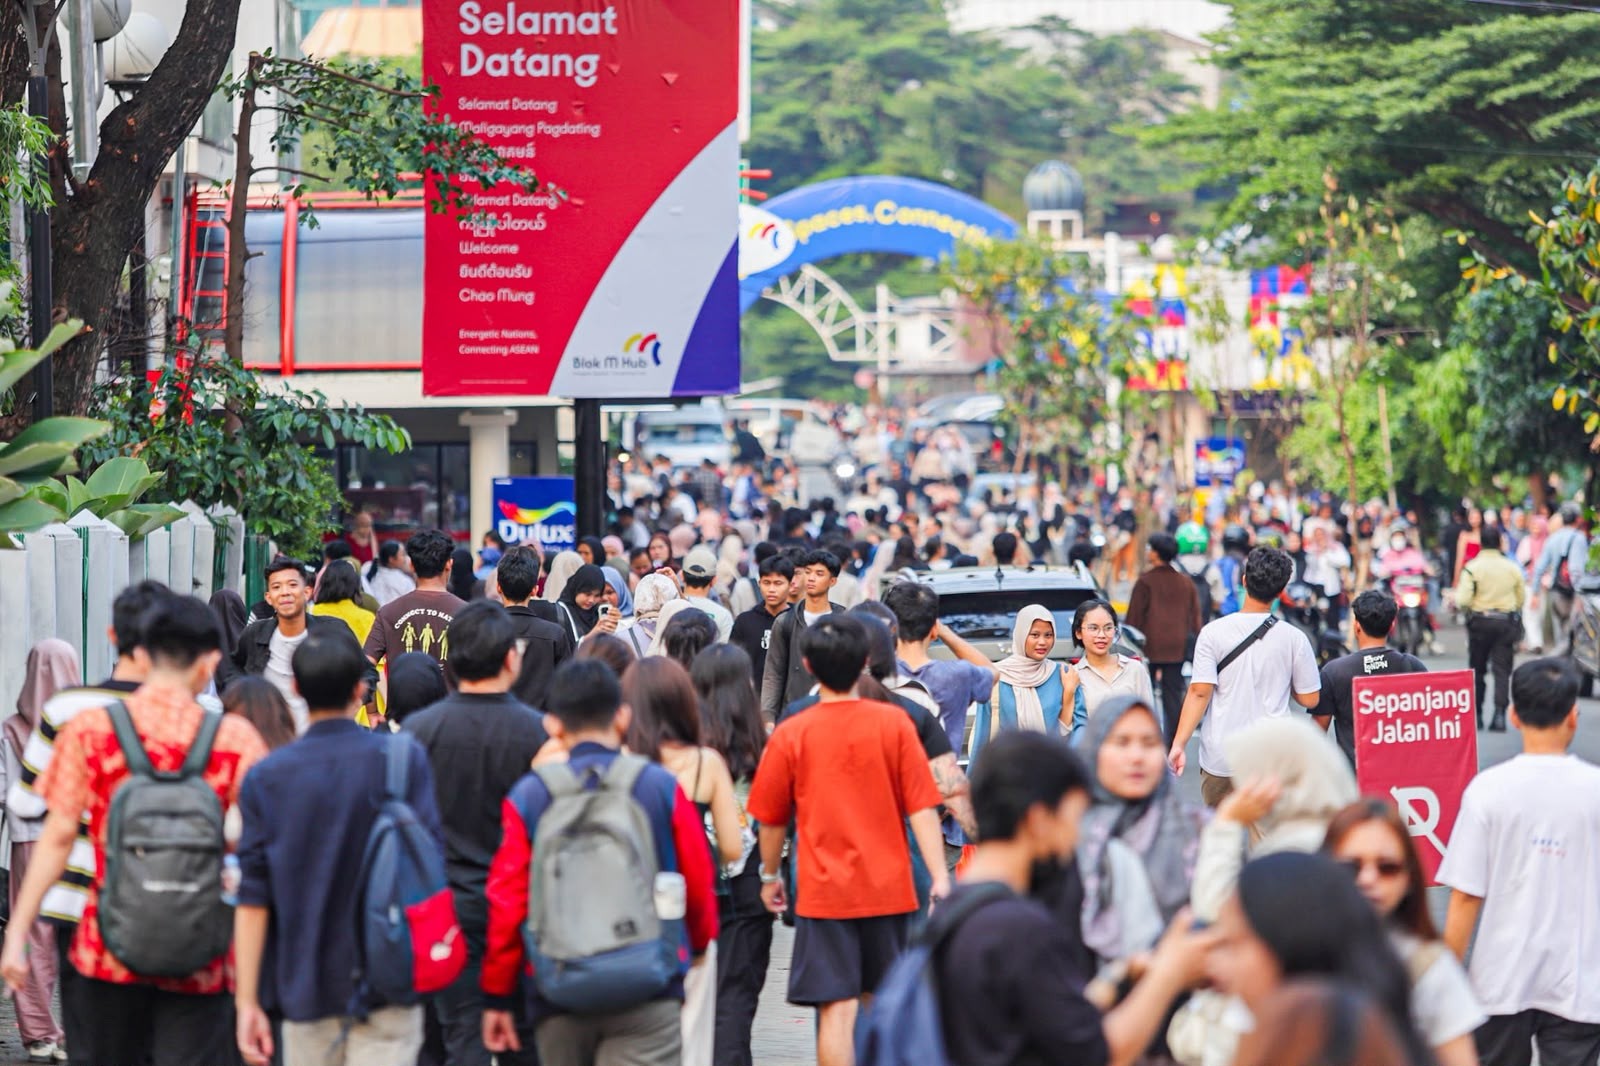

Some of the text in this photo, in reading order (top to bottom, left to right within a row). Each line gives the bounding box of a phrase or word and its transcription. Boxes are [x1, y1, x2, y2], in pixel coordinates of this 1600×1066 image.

[459, 1, 618, 35] Selamat
[460, 43, 600, 87] Datang
[458, 97, 558, 114] Selamat Datang
[459, 121, 600, 138] Maligayang Pagdating
[460, 192, 557, 210] lamat Datang
[459, 241, 519, 254] Welcome
[459, 287, 535, 305] Chao Mung
[459, 328, 500, 341] Energetic
[459, 344, 539, 356] Connecting ASEAN
[573, 356, 647, 369] Blok M Hub
[498, 520, 576, 544] Dulux
[438, 611, 454, 622] NAT
[1358, 685, 1470, 718] Sepanjang
[1371, 714, 1461, 744] Jalan Ini
